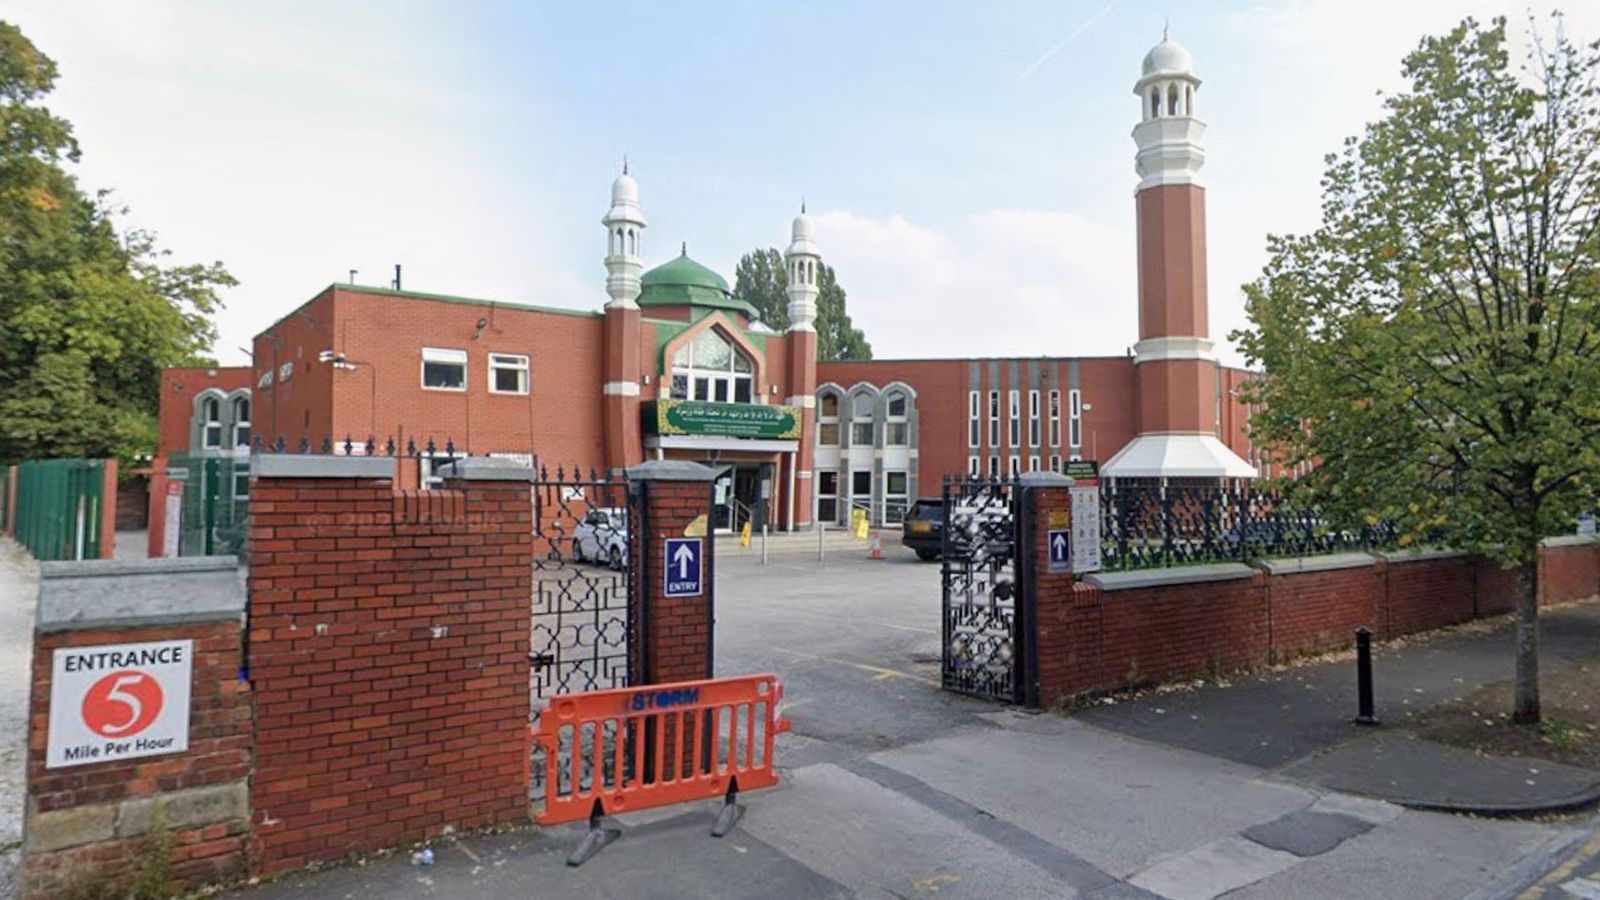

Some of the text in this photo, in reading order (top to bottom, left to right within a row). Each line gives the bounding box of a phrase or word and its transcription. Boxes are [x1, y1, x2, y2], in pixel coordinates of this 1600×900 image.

[669, 581, 698, 593] ENTRY
[64, 646, 183, 672] ENTRANCE
[101, 674, 146, 734] 5
[632, 687, 700, 711] STORM
[64, 737, 175, 761] Mile Per Hour
